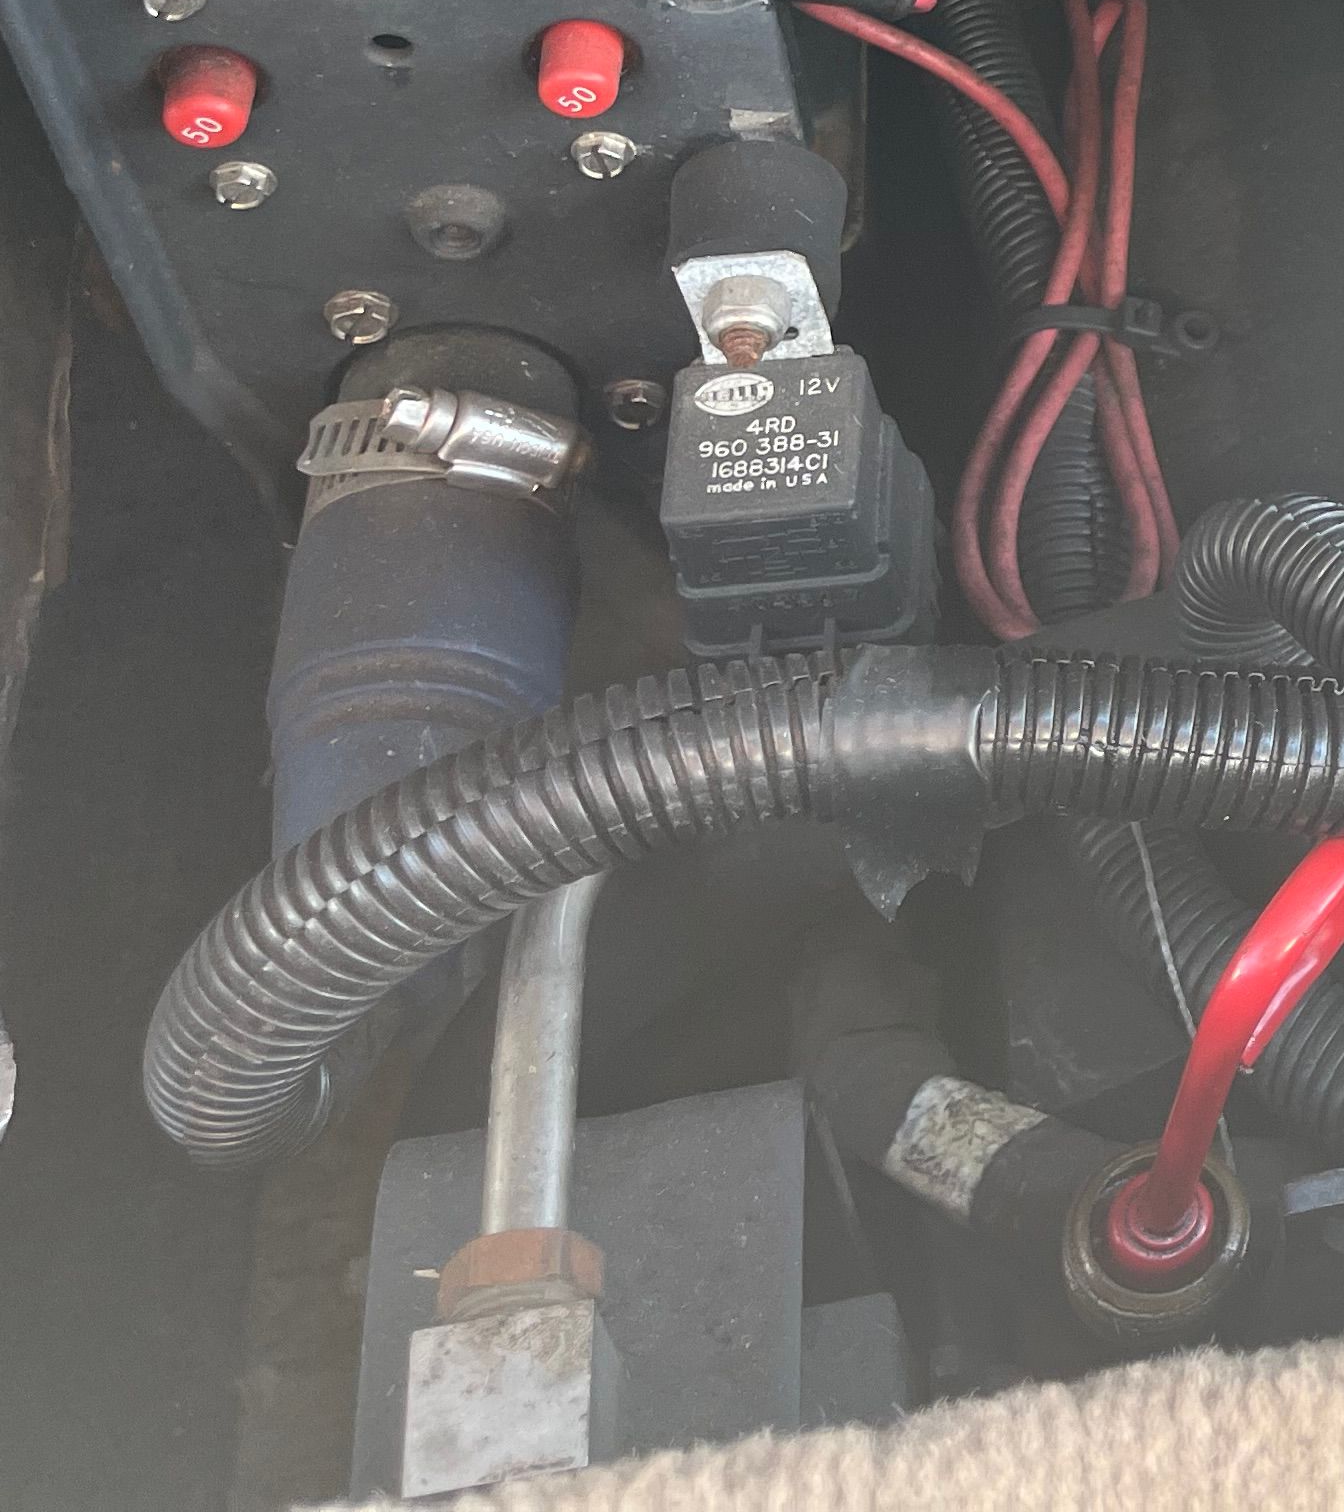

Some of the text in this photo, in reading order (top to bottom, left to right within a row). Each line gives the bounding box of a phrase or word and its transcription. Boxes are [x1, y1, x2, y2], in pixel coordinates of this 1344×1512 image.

[557, 86, 598, 113] 50
[182, 116, 223, 145] 50
[799, 376, 841, 396] 12V
[745, 415, 797, 436] 4RD
[698, 429, 840, 459] 960 388-31
[706, 479, 755, 494] made
[760, 476, 777, 491] in
